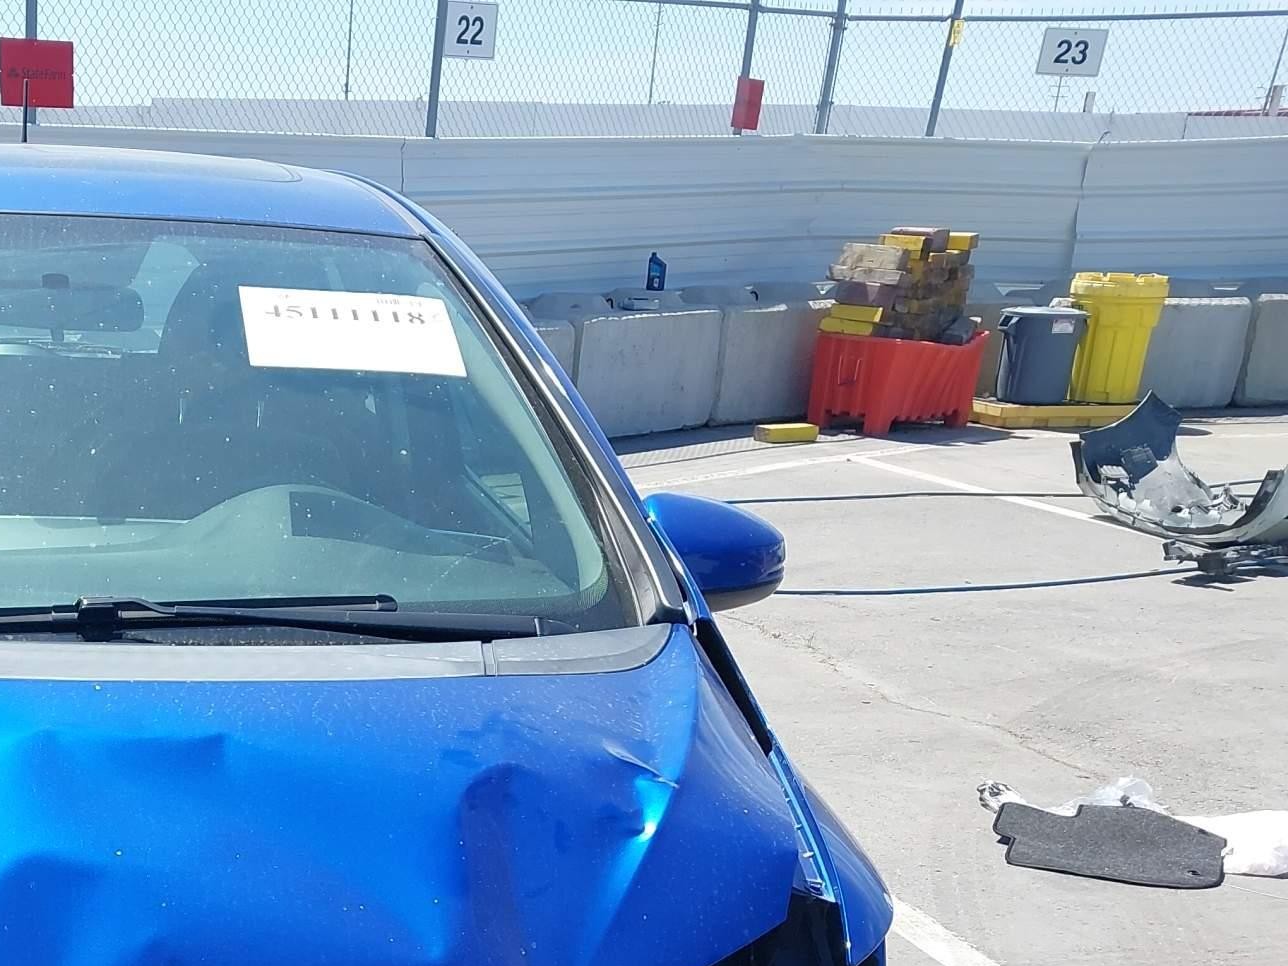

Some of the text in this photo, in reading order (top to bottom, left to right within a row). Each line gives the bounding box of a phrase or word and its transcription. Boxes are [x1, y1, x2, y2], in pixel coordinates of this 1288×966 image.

[456, 15, 484, 45] 22
[1053, 39, 1089, 65] 23
[265, 303, 426, 326] 45111118
